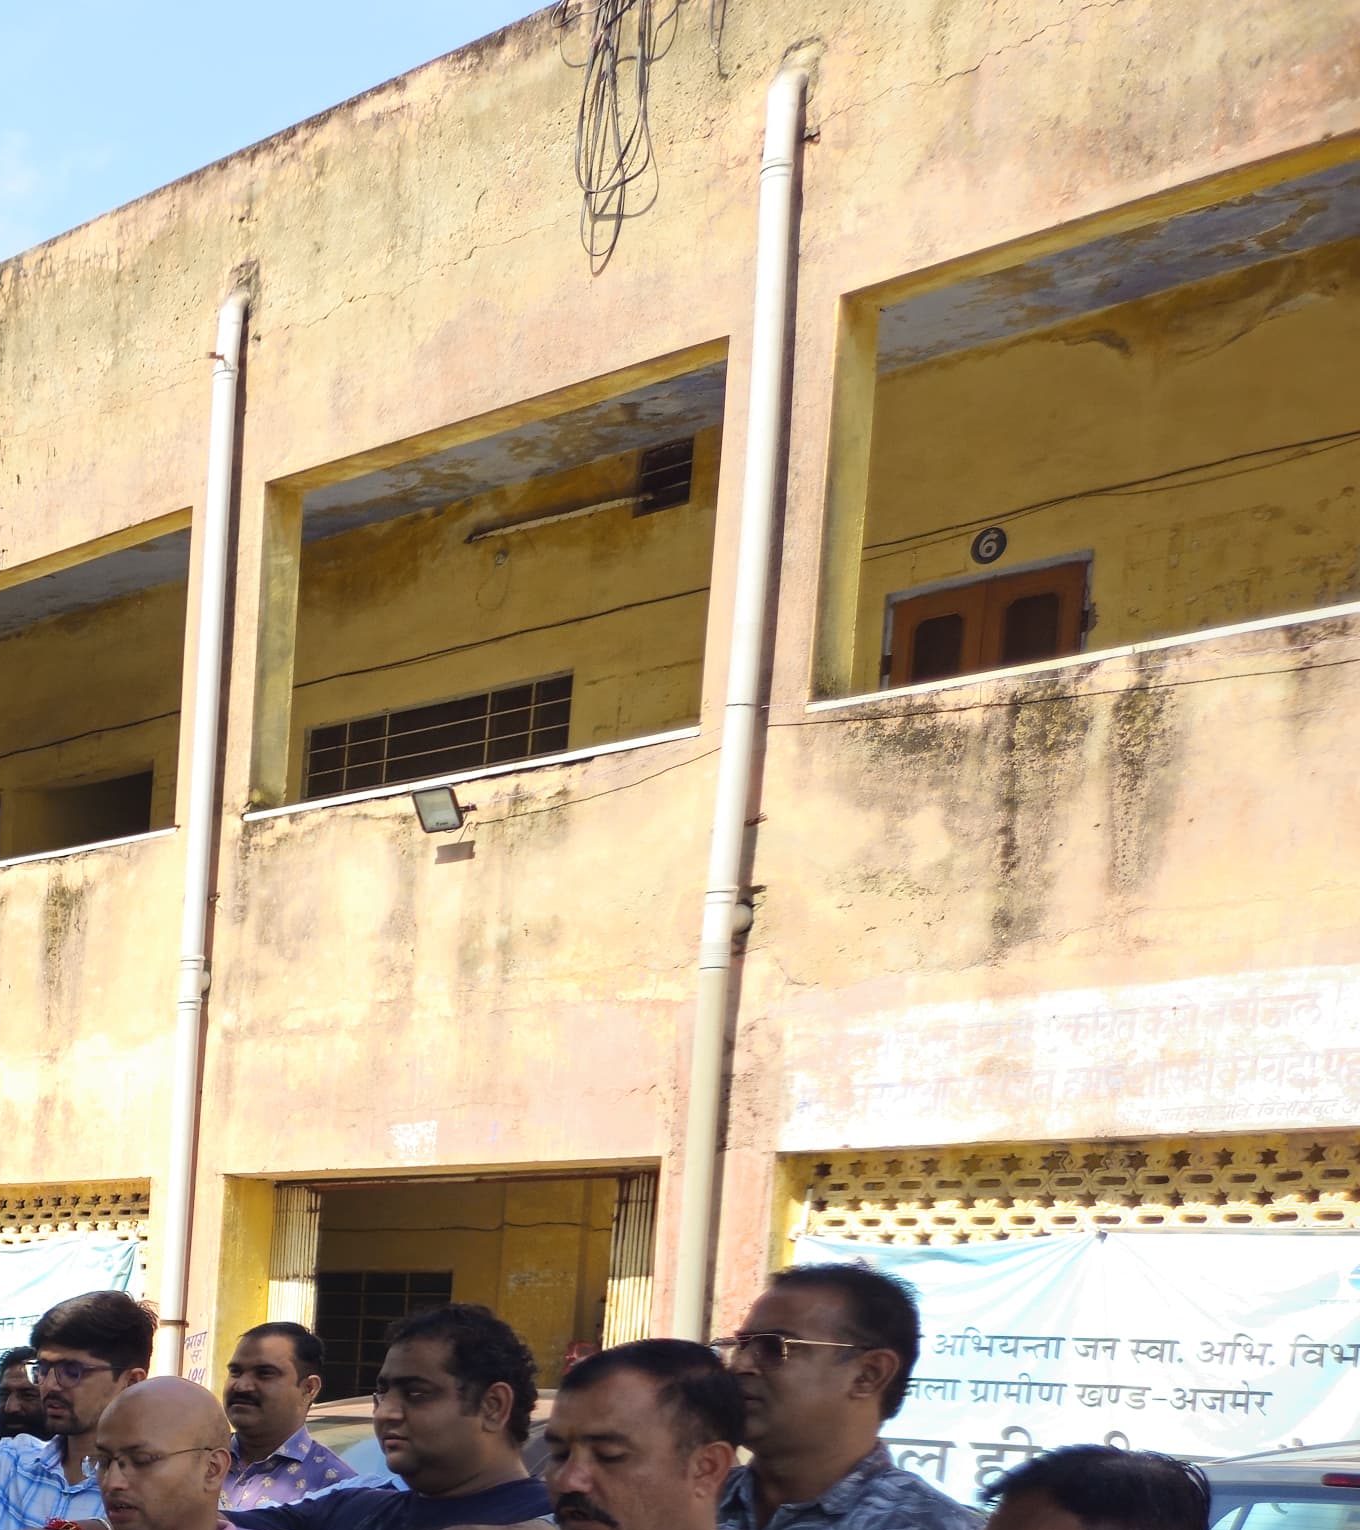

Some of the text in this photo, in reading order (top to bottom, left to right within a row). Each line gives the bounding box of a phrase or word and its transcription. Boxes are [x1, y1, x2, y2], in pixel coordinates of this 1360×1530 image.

[979, 533, 998, 557] 6
[933, 1326, 1360, 1367] अभियन्ता जन स्वा. अभि. विभ
[968, 1372, 1067, 1405] ग्रामीण
[882, 1437, 957, 1484] ल
